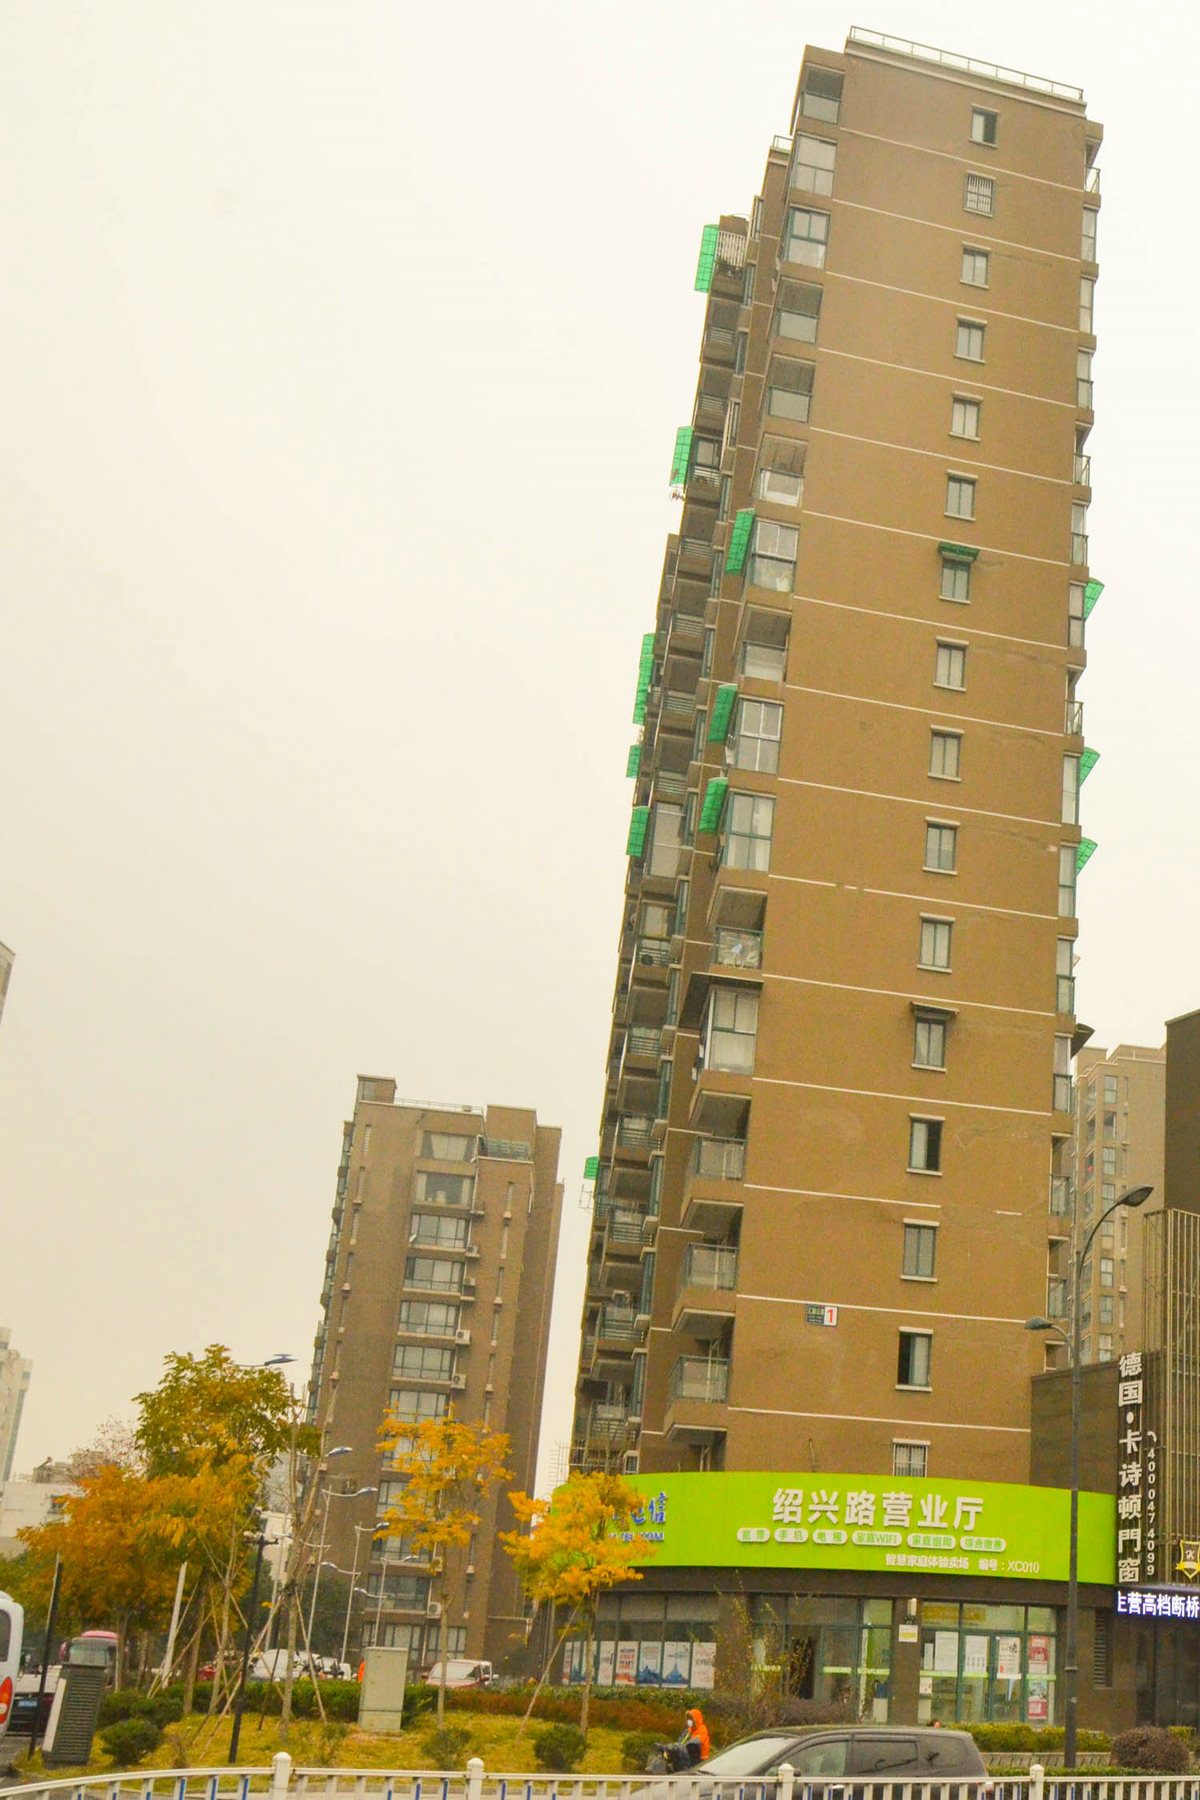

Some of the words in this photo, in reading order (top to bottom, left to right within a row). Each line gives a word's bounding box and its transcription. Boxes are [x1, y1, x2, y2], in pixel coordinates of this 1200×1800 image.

[772, 1487, 985, 1532] 绍兴路营业厅
